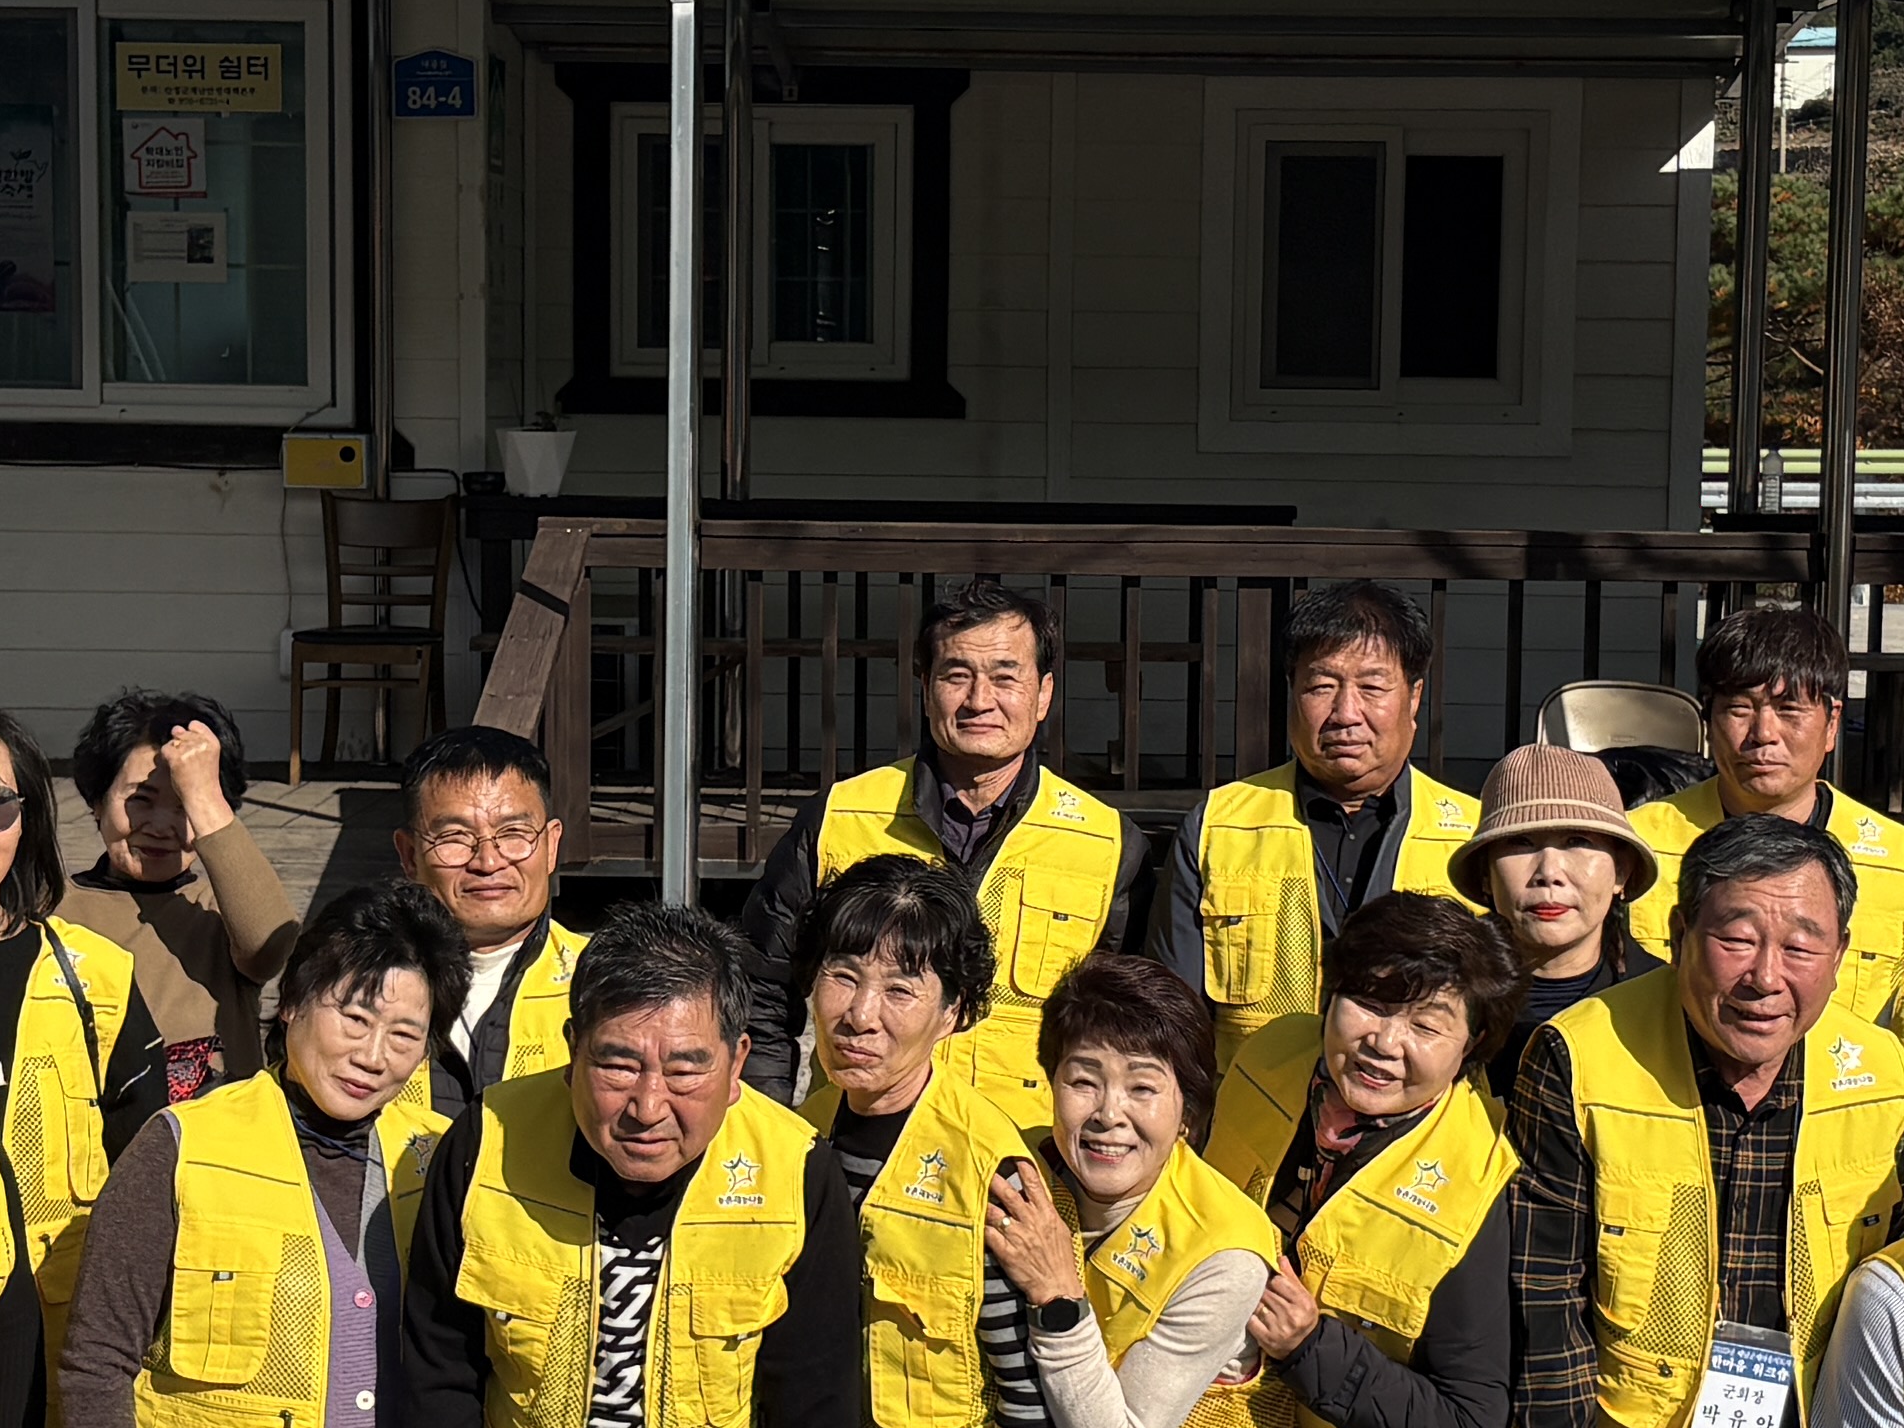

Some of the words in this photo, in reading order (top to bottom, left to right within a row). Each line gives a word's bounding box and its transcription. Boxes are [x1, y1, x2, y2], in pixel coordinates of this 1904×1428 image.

[127, 54, 205, 80] 무더위
[218, 55, 269, 81] 쉼터
[406, 84, 464, 110] 84-4
